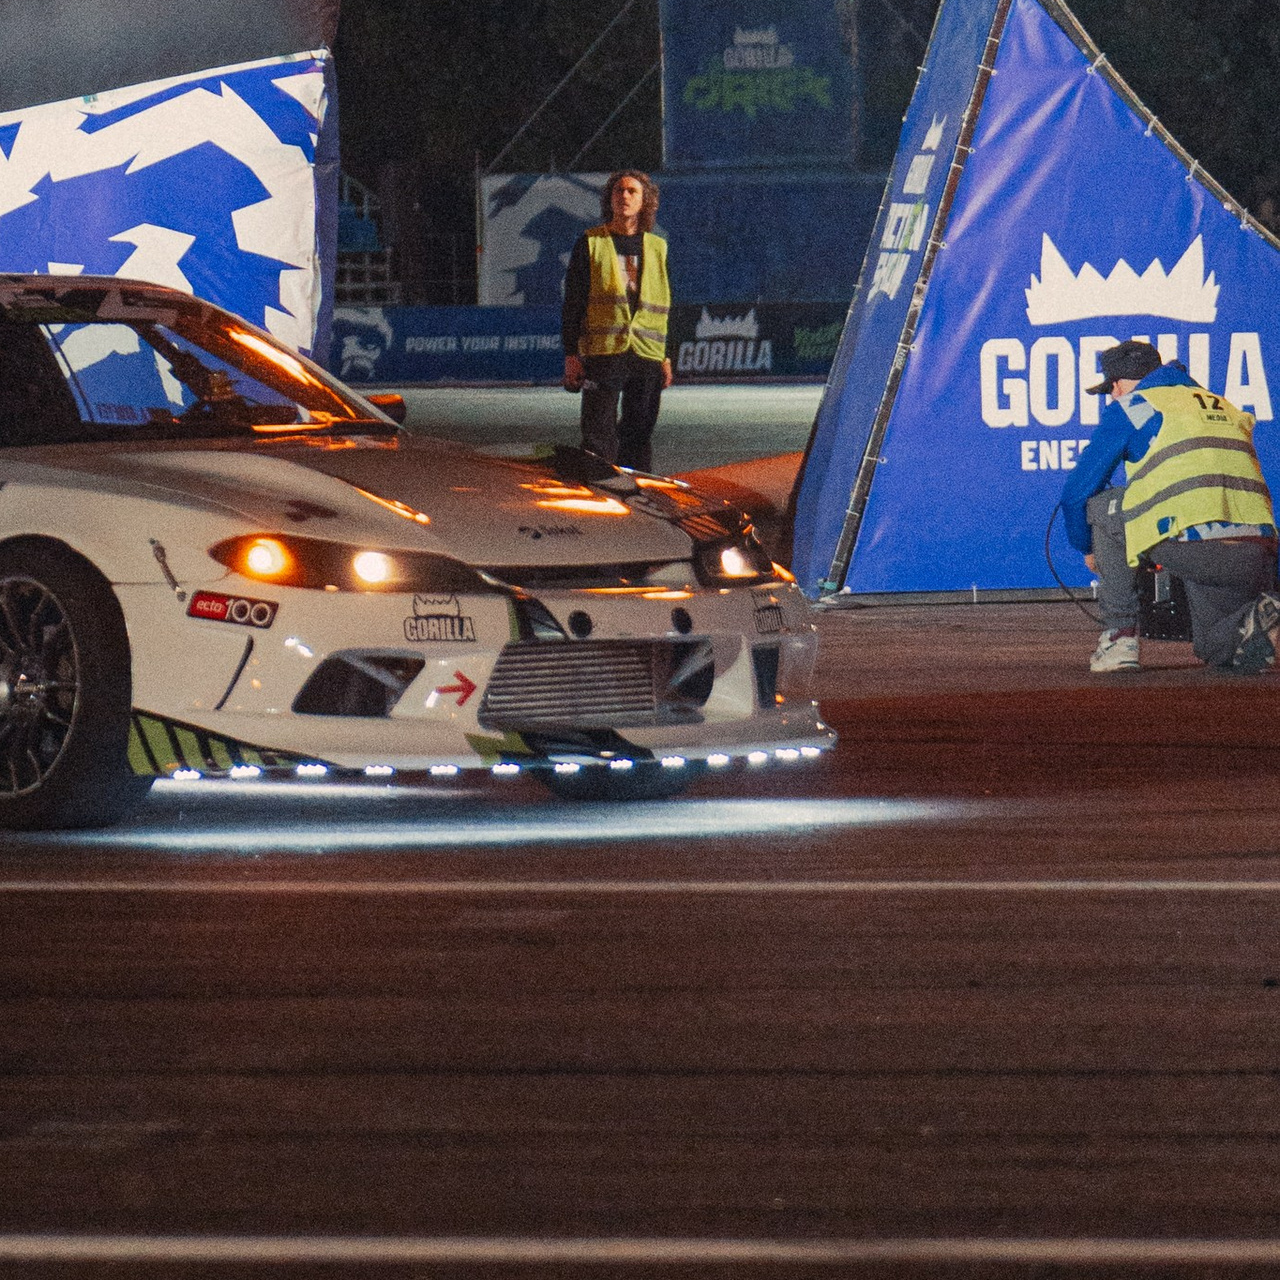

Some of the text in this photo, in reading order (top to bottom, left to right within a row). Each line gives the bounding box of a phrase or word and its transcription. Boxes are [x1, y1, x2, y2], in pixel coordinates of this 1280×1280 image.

[406, 335, 561, 352] POWER YOUR INSTINC
[677, 340, 772, 371] GORILLA
[980, 332, 1274, 428] GORA
[1193, 393, 1224, 411] 12
[1206, 414, 1228, 422] MEDIA
[1021, 439, 1091, 471] ENE
[403, 615, 477, 642] GORILLA
